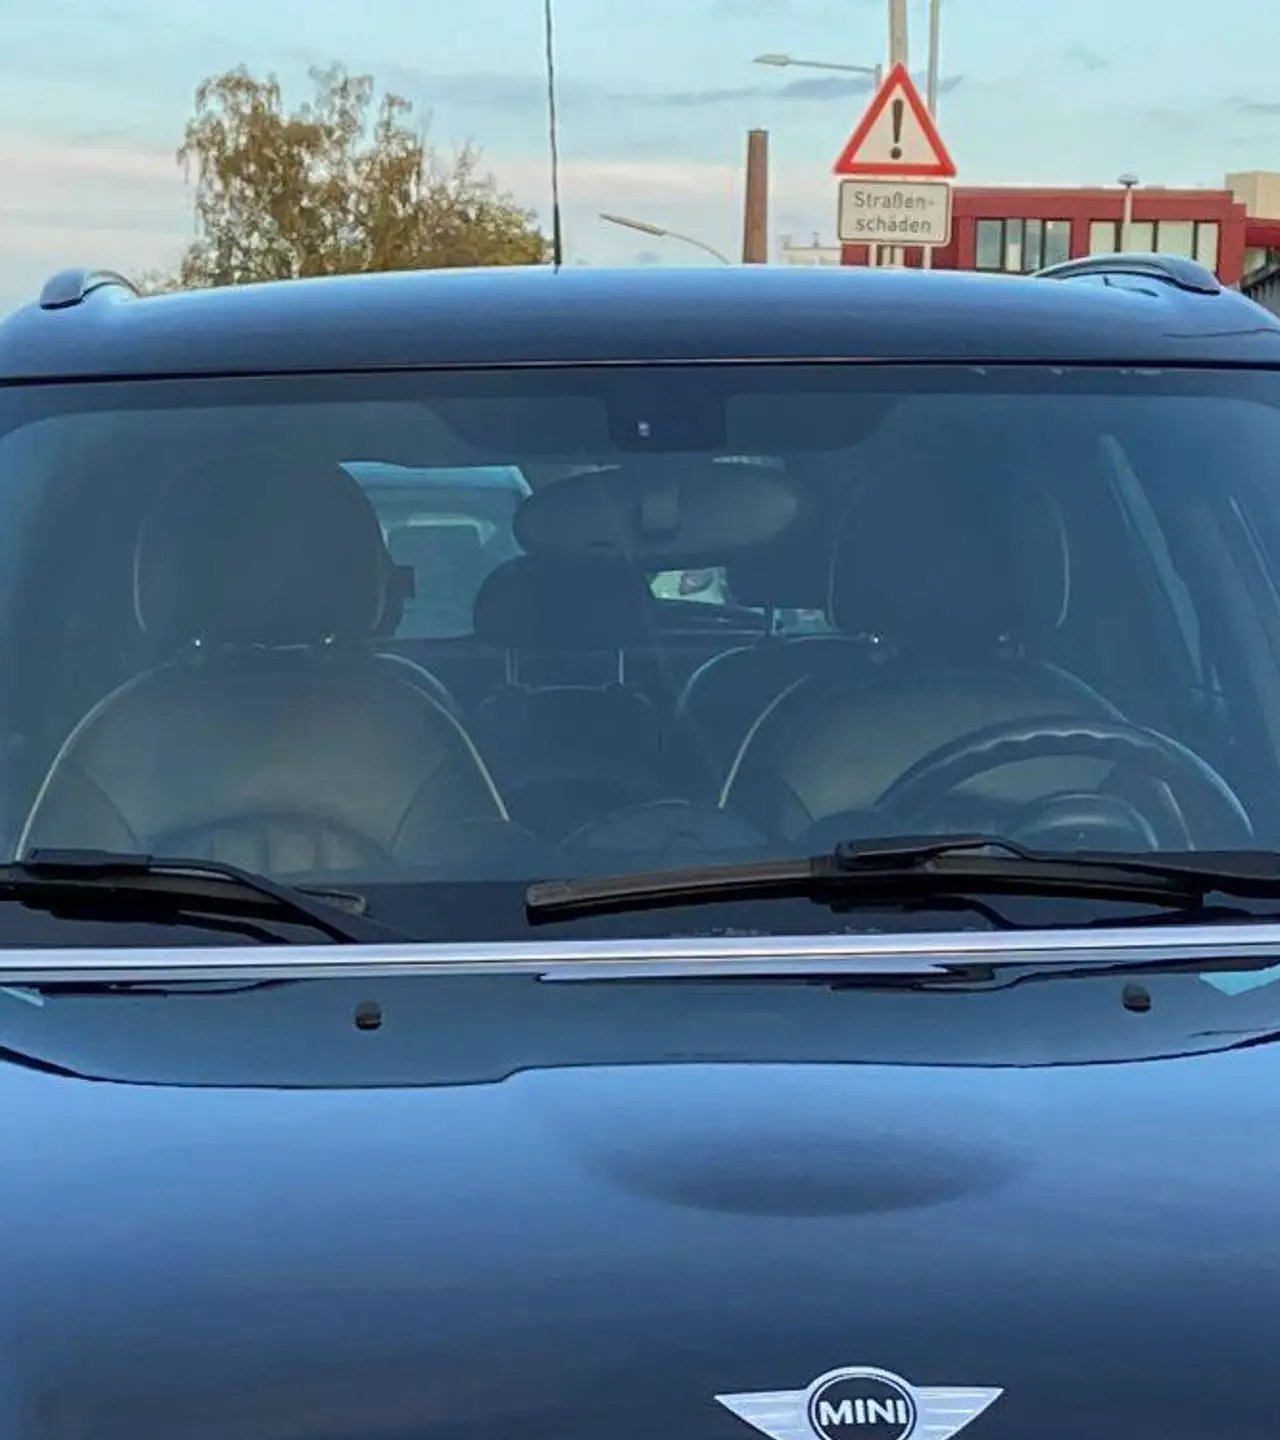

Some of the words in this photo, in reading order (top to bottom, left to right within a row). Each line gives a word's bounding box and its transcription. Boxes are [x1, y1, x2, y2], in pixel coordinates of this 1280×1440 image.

[854, 190, 937, 210] Straßen-
[855, 215, 933, 234] schäden
[819, 1397, 908, 1427] MINI
